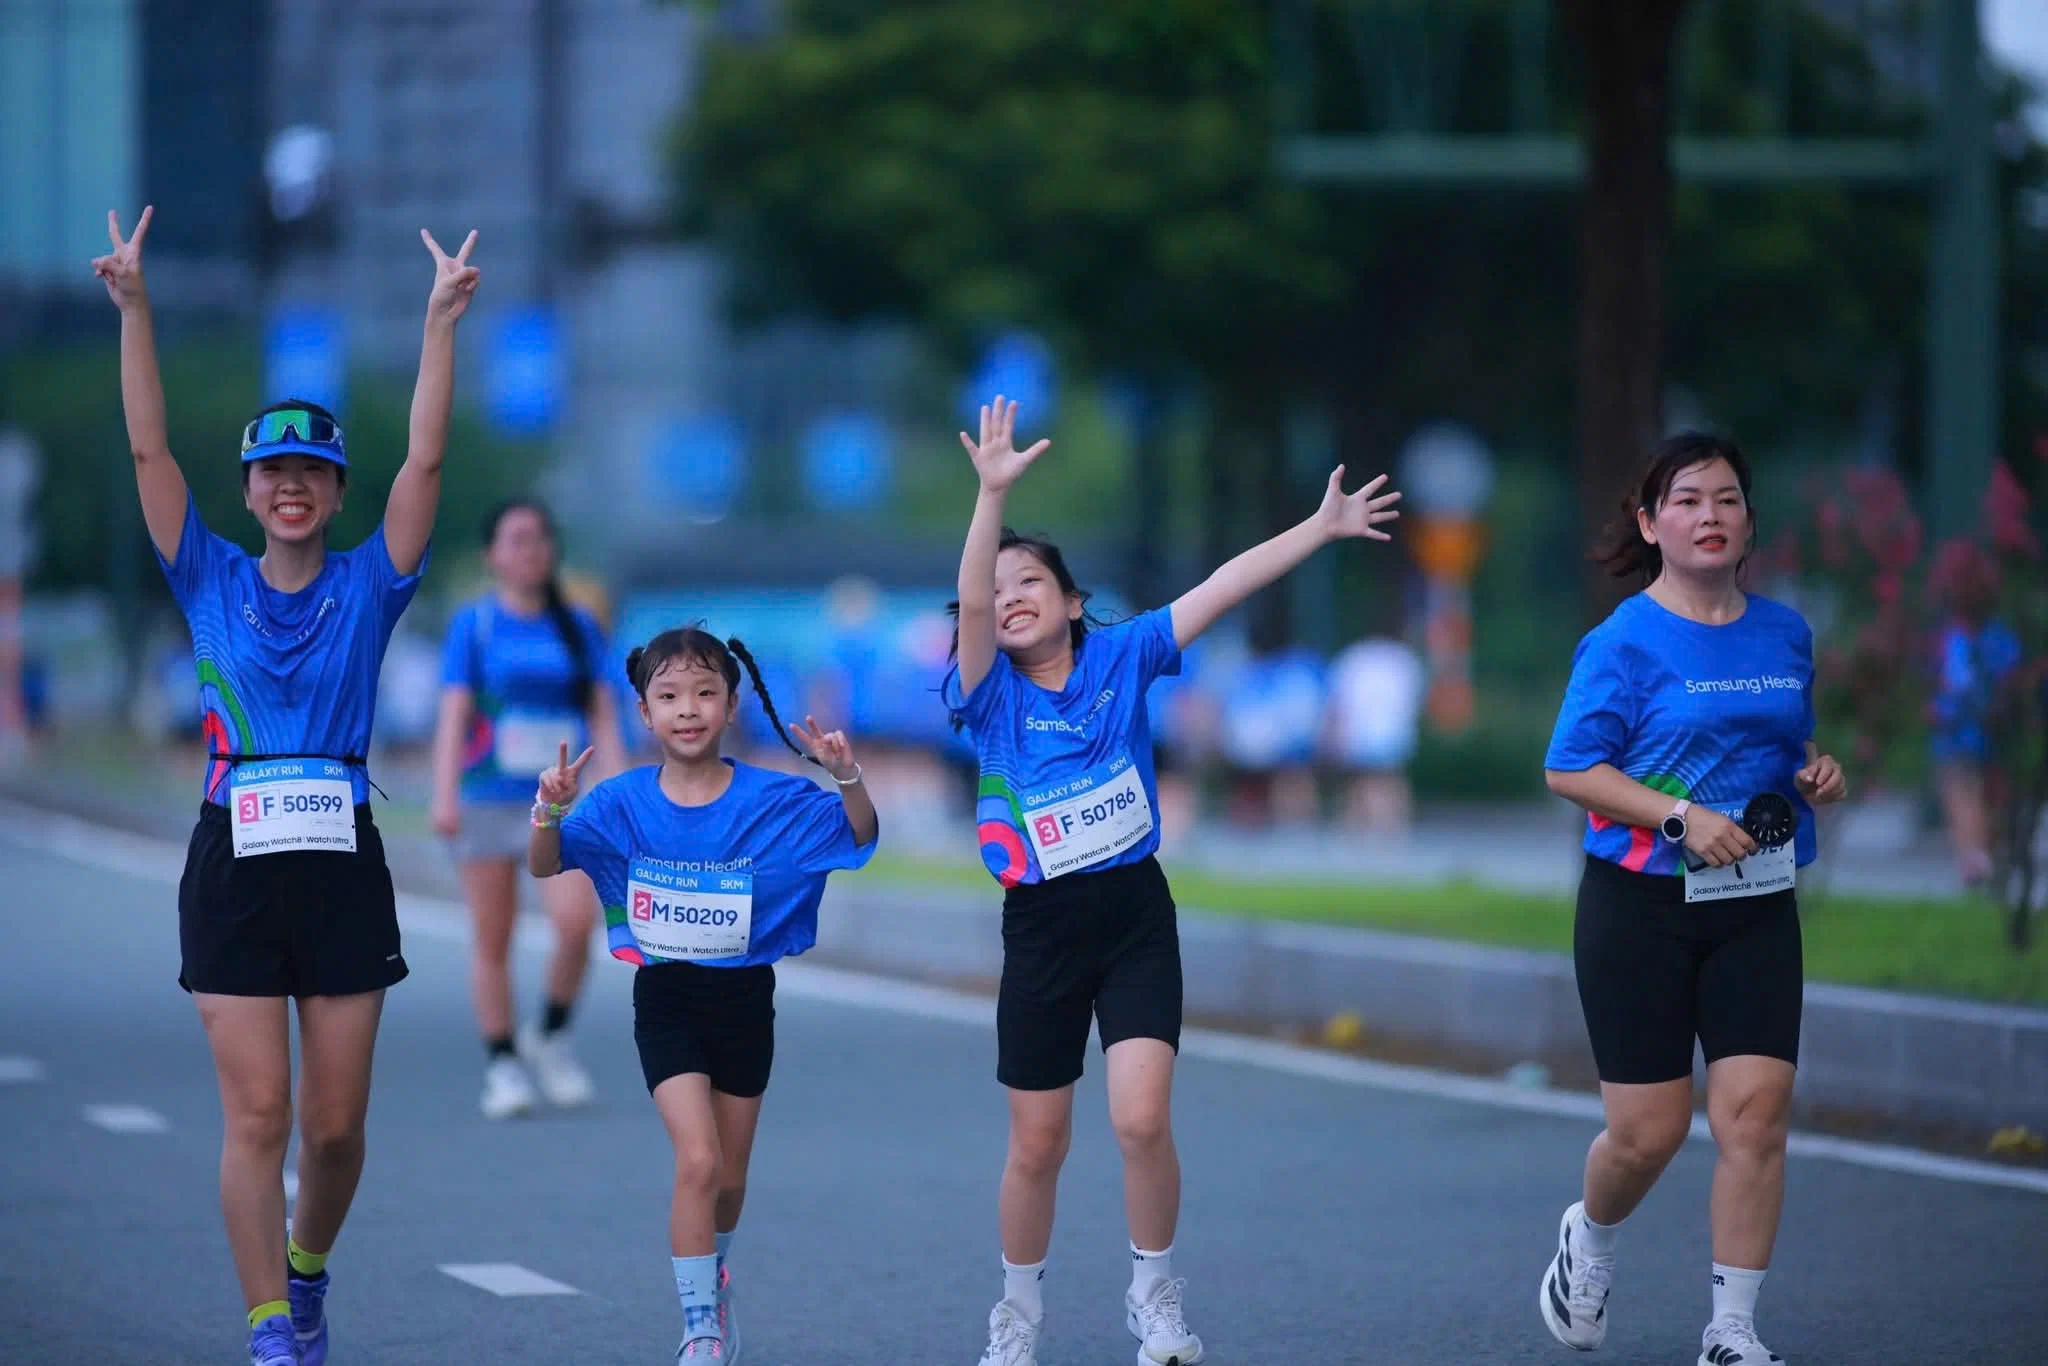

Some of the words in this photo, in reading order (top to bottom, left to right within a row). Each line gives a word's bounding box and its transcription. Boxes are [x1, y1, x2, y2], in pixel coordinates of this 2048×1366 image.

[1685, 679, 1761, 694] Samsung
[238, 767, 279, 781] GALAXY
[281, 765, 304, 776] RUN
[324, 765, 344, 776] 5KM
[1026, 786, 1069, 806] GALAXY
[1071, 776, 1093, 792] RUN
[1109, 756, 1128, 774] 5KM
[242, 799, 256, 819] 3
[263, 796, 275, 816] F
[283, 795, 343, 813] 50599
[1039, 821, 1056, 842] 3
[1060, 814, 1074, 834] F
[1081, 786, 1136, 826] 50786
[242, 840, 270, 850] Galaxy
[271, 837, 302, 846] Watch8
[306, 836, 332, 844] Watch
[333, 837, 350, 845] Ultra
[1050, 856, 1080, 872] Galaxy
[1079, 844, 1111, 861] Watch8
[1114, 831, 1136, 848] Watch
[704, 856, 752, 873] Health
[636, 868, 674, 886] GALAXY
[676, 877, 698, 888] RUN
[721, 880, 744, 890] 5KM
[1692, 885, 1720, 897] Galaxy
[1721, 881, 1752, 892] Watch8
[1755, 879, 1777, 889] Watch
[636, 897, 649, 918] 2
[652, 900, 669, 922] M
[674, 906, 738, 926] 50209
[657, 942, 688, 953] Watch8
